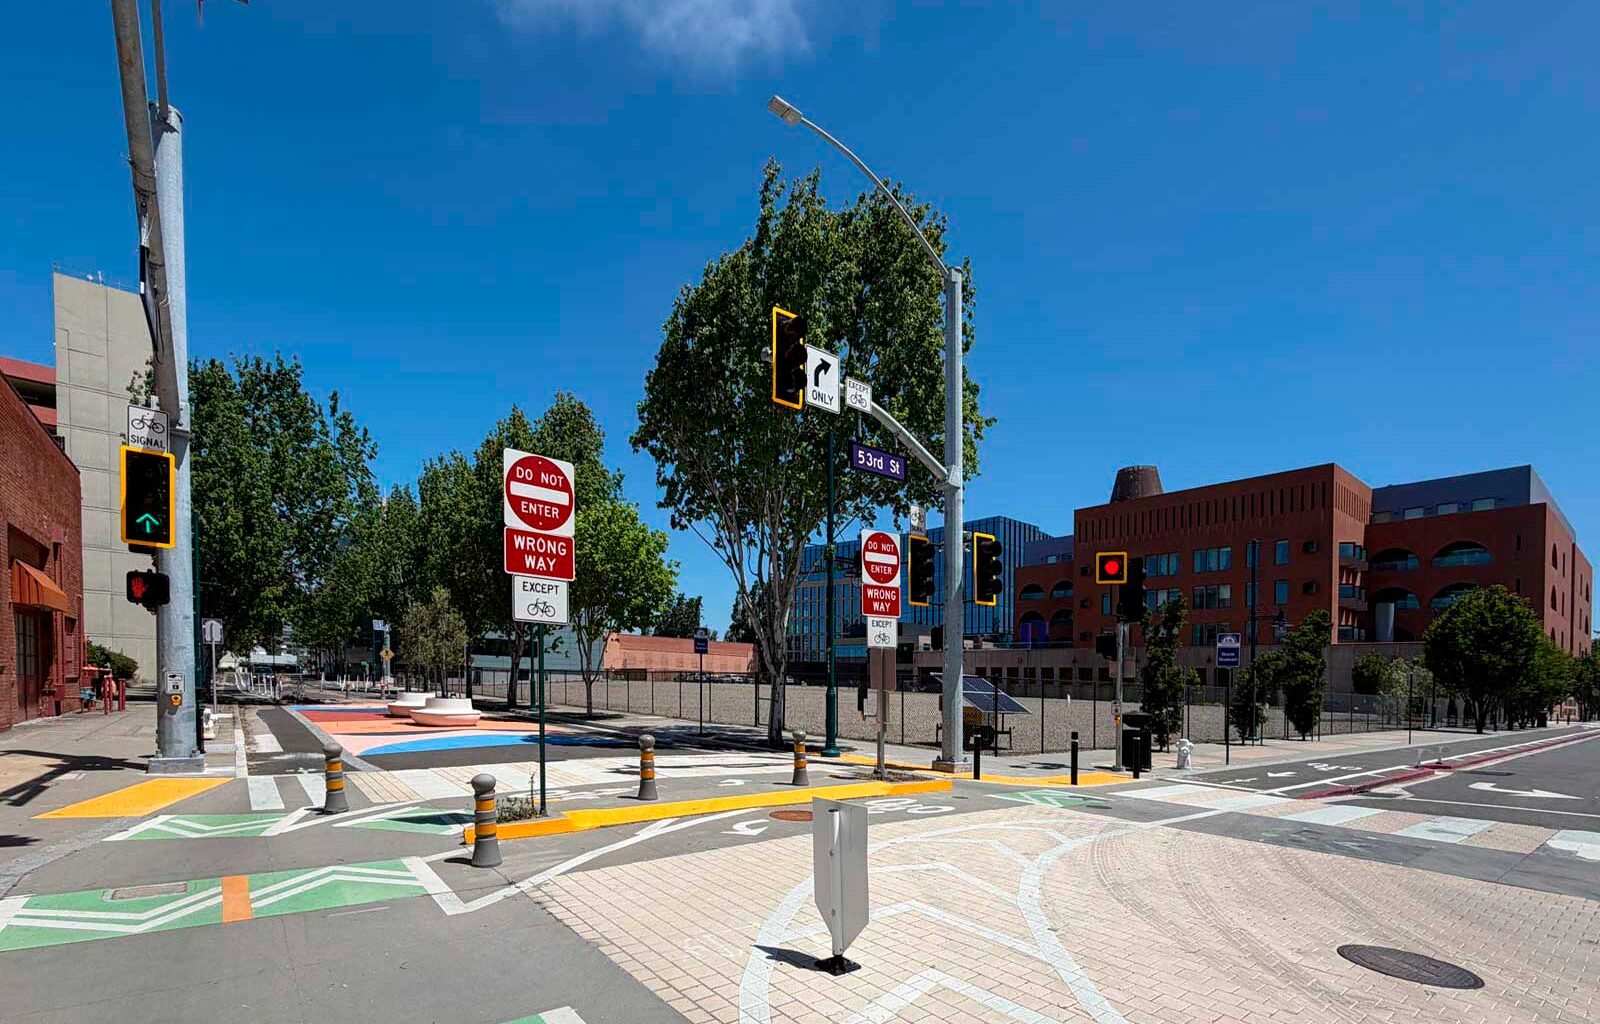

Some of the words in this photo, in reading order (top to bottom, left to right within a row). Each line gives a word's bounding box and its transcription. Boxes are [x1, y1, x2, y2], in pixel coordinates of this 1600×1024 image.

[812, 390, 833, 406] ONLY
[131, 435, 166, 448] SIGNAL
[858, 450, 883, 470] 53rd
[890, 460, 900, 474] St
[516, 467, 533, 480] DO
[541, 472, 564, 487] NOT
[521, 501, 559, 519] ENTER
[514, 535, 567, 555] WRONG
[868, 541, 877, 549] DO
[882, 544, 894, 552] NOT
[525, 554, 556, 571] WAY
[871, 565, 892, 574] ENTER
[522, 582, 559, 595] EXCEPT
[867, 589, 896, 600] WRONG
[873, 602, 890, 612] WAY
[872, 620, 892, 628] EXCEPT
